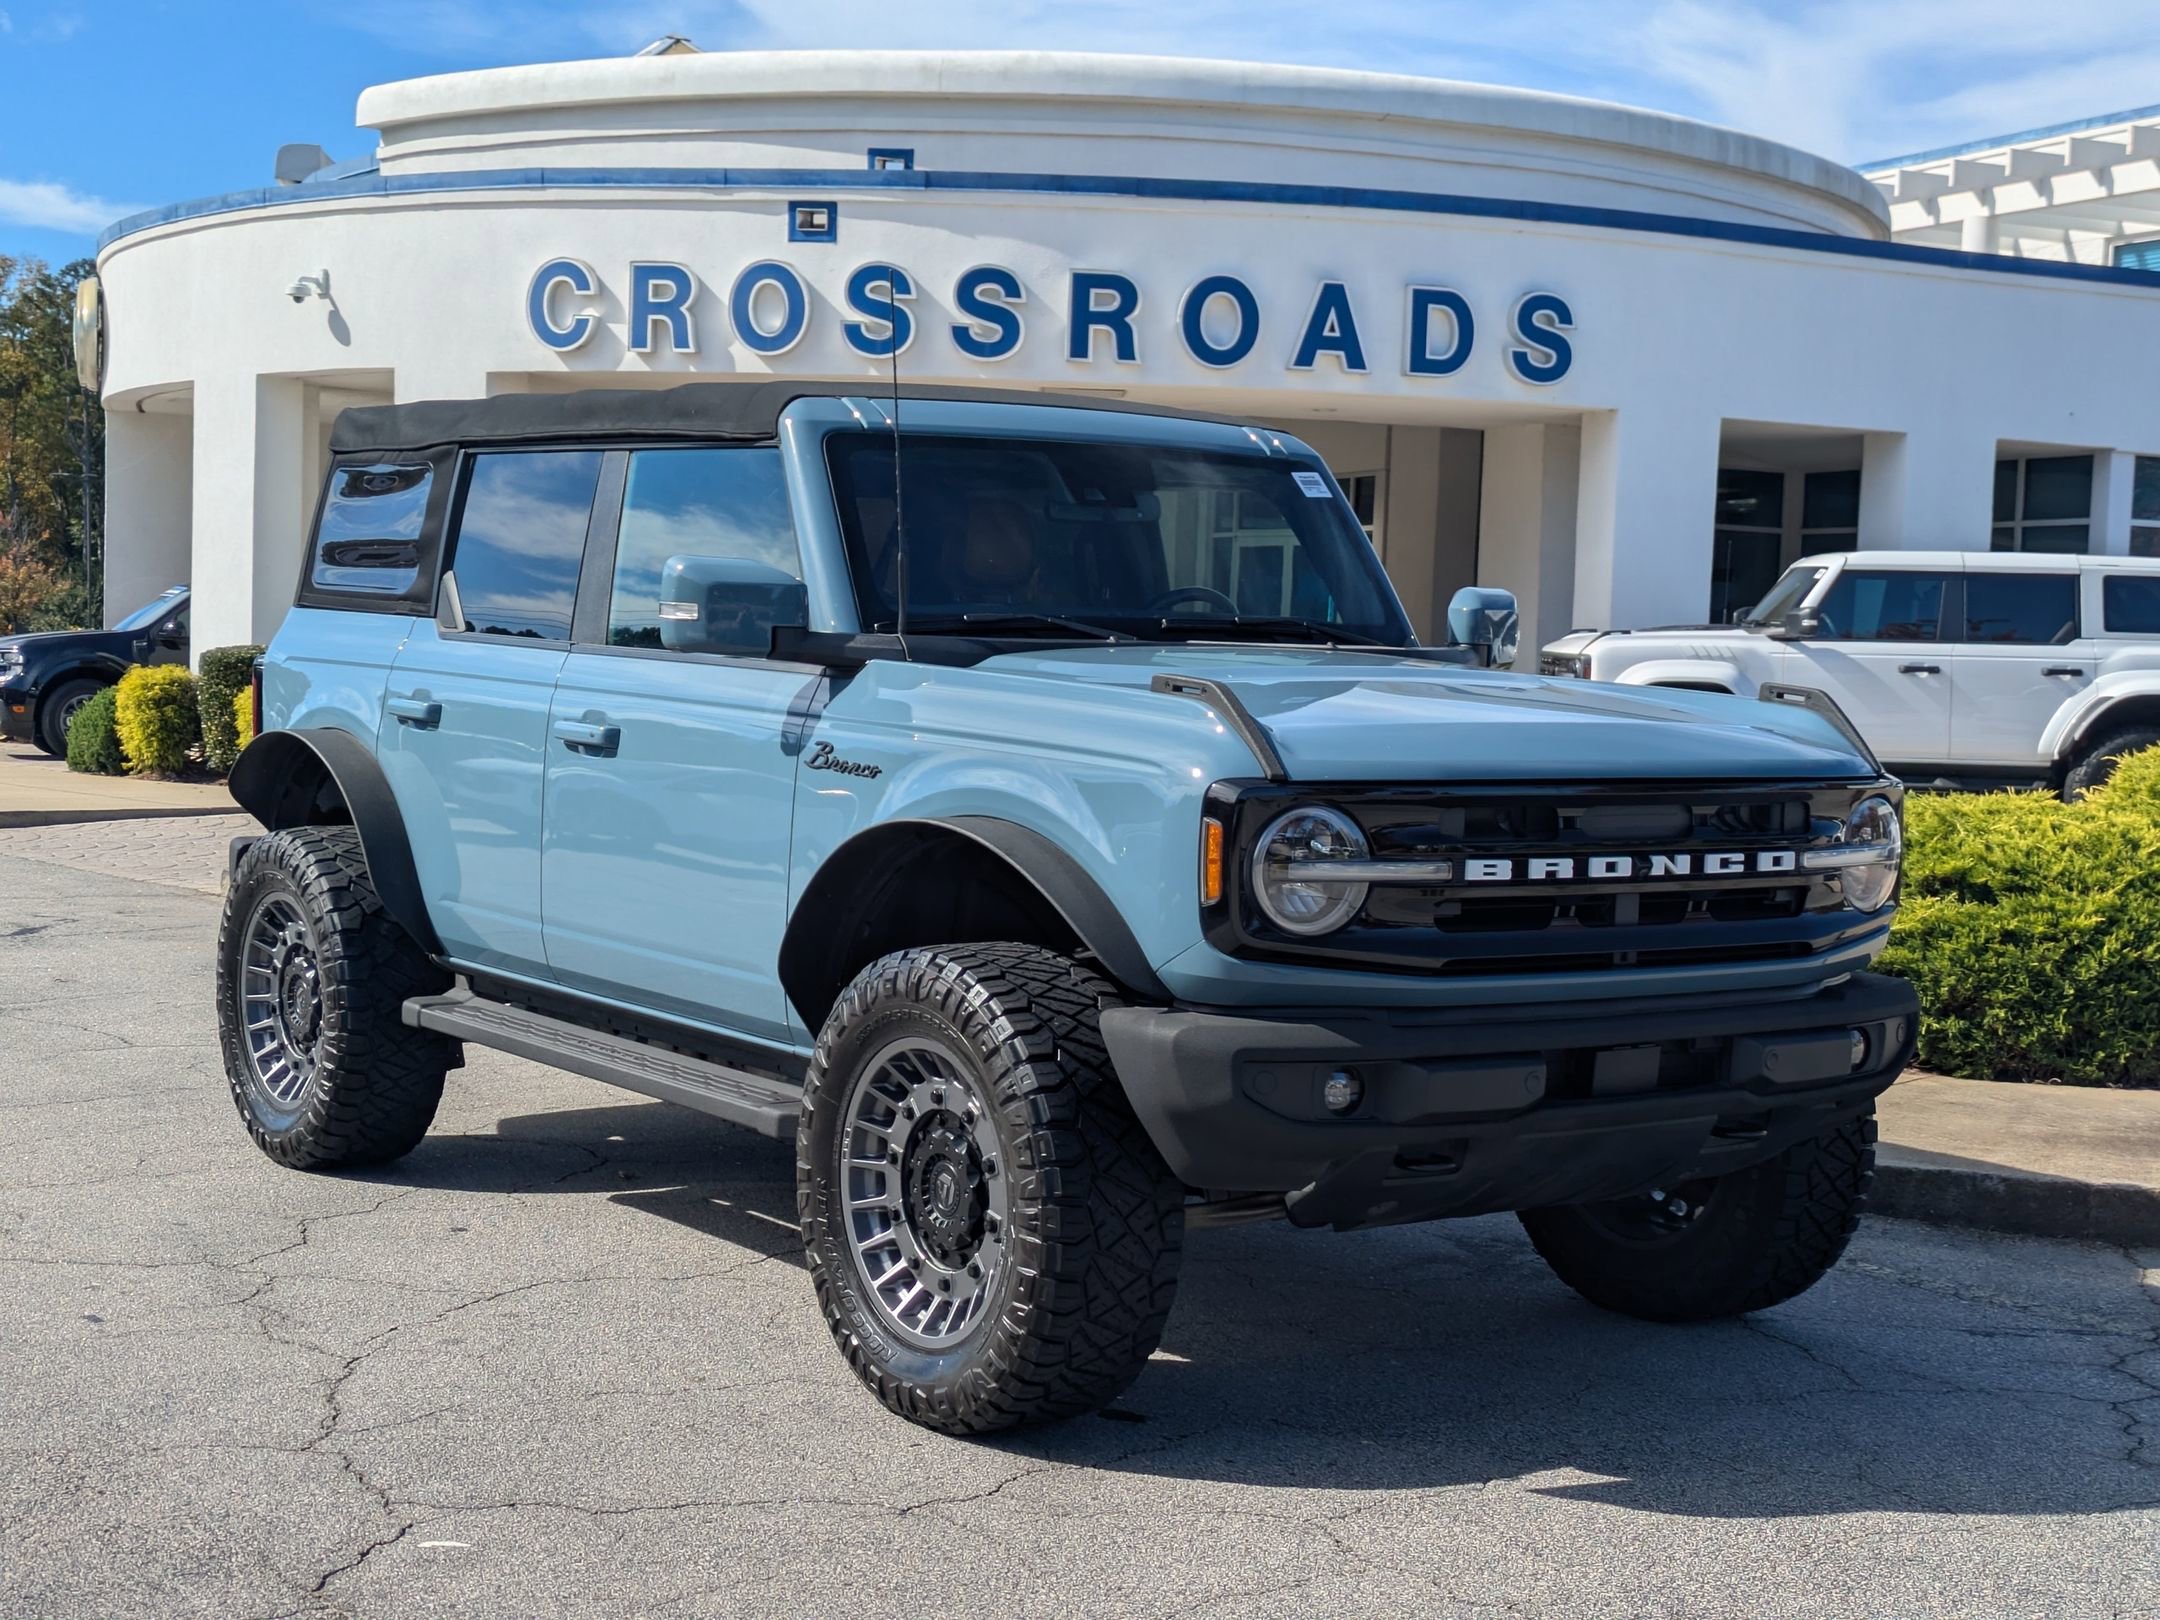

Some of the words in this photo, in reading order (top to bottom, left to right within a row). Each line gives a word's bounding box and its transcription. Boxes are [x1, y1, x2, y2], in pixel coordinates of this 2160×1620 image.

[527, 257, 1576, 386] CROSSROADS
[803, 740, 883, 779] Bronco
[1464, 851, 1796, 881] BRONCO
